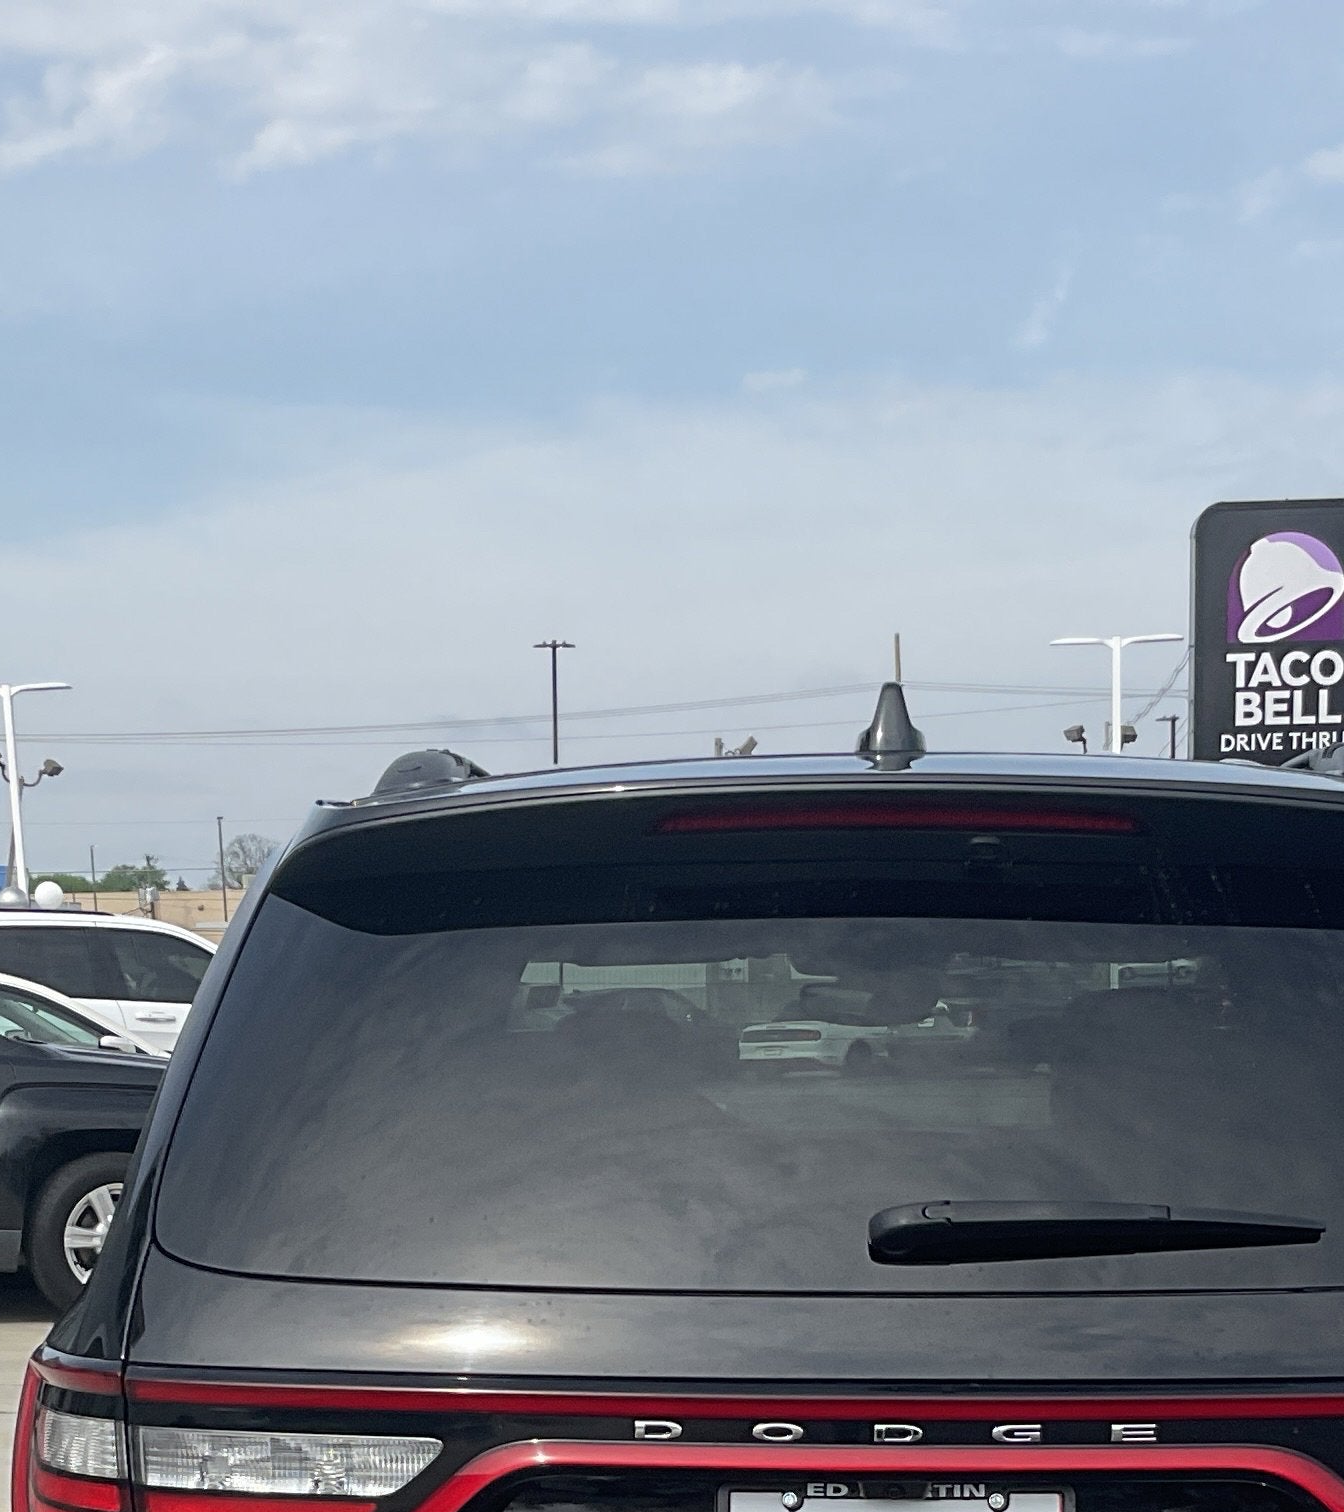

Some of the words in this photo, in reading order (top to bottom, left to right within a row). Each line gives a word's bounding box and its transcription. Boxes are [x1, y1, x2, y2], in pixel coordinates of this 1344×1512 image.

[1226, 650, 1344, 689] TACO
[1234, 688, 1343, 727] BELL
[1220, 732, 1284, 753] DRIVE
[634, 1419, 1157, 1443] DODGE
[807, 1483, 849, 1498] ED
